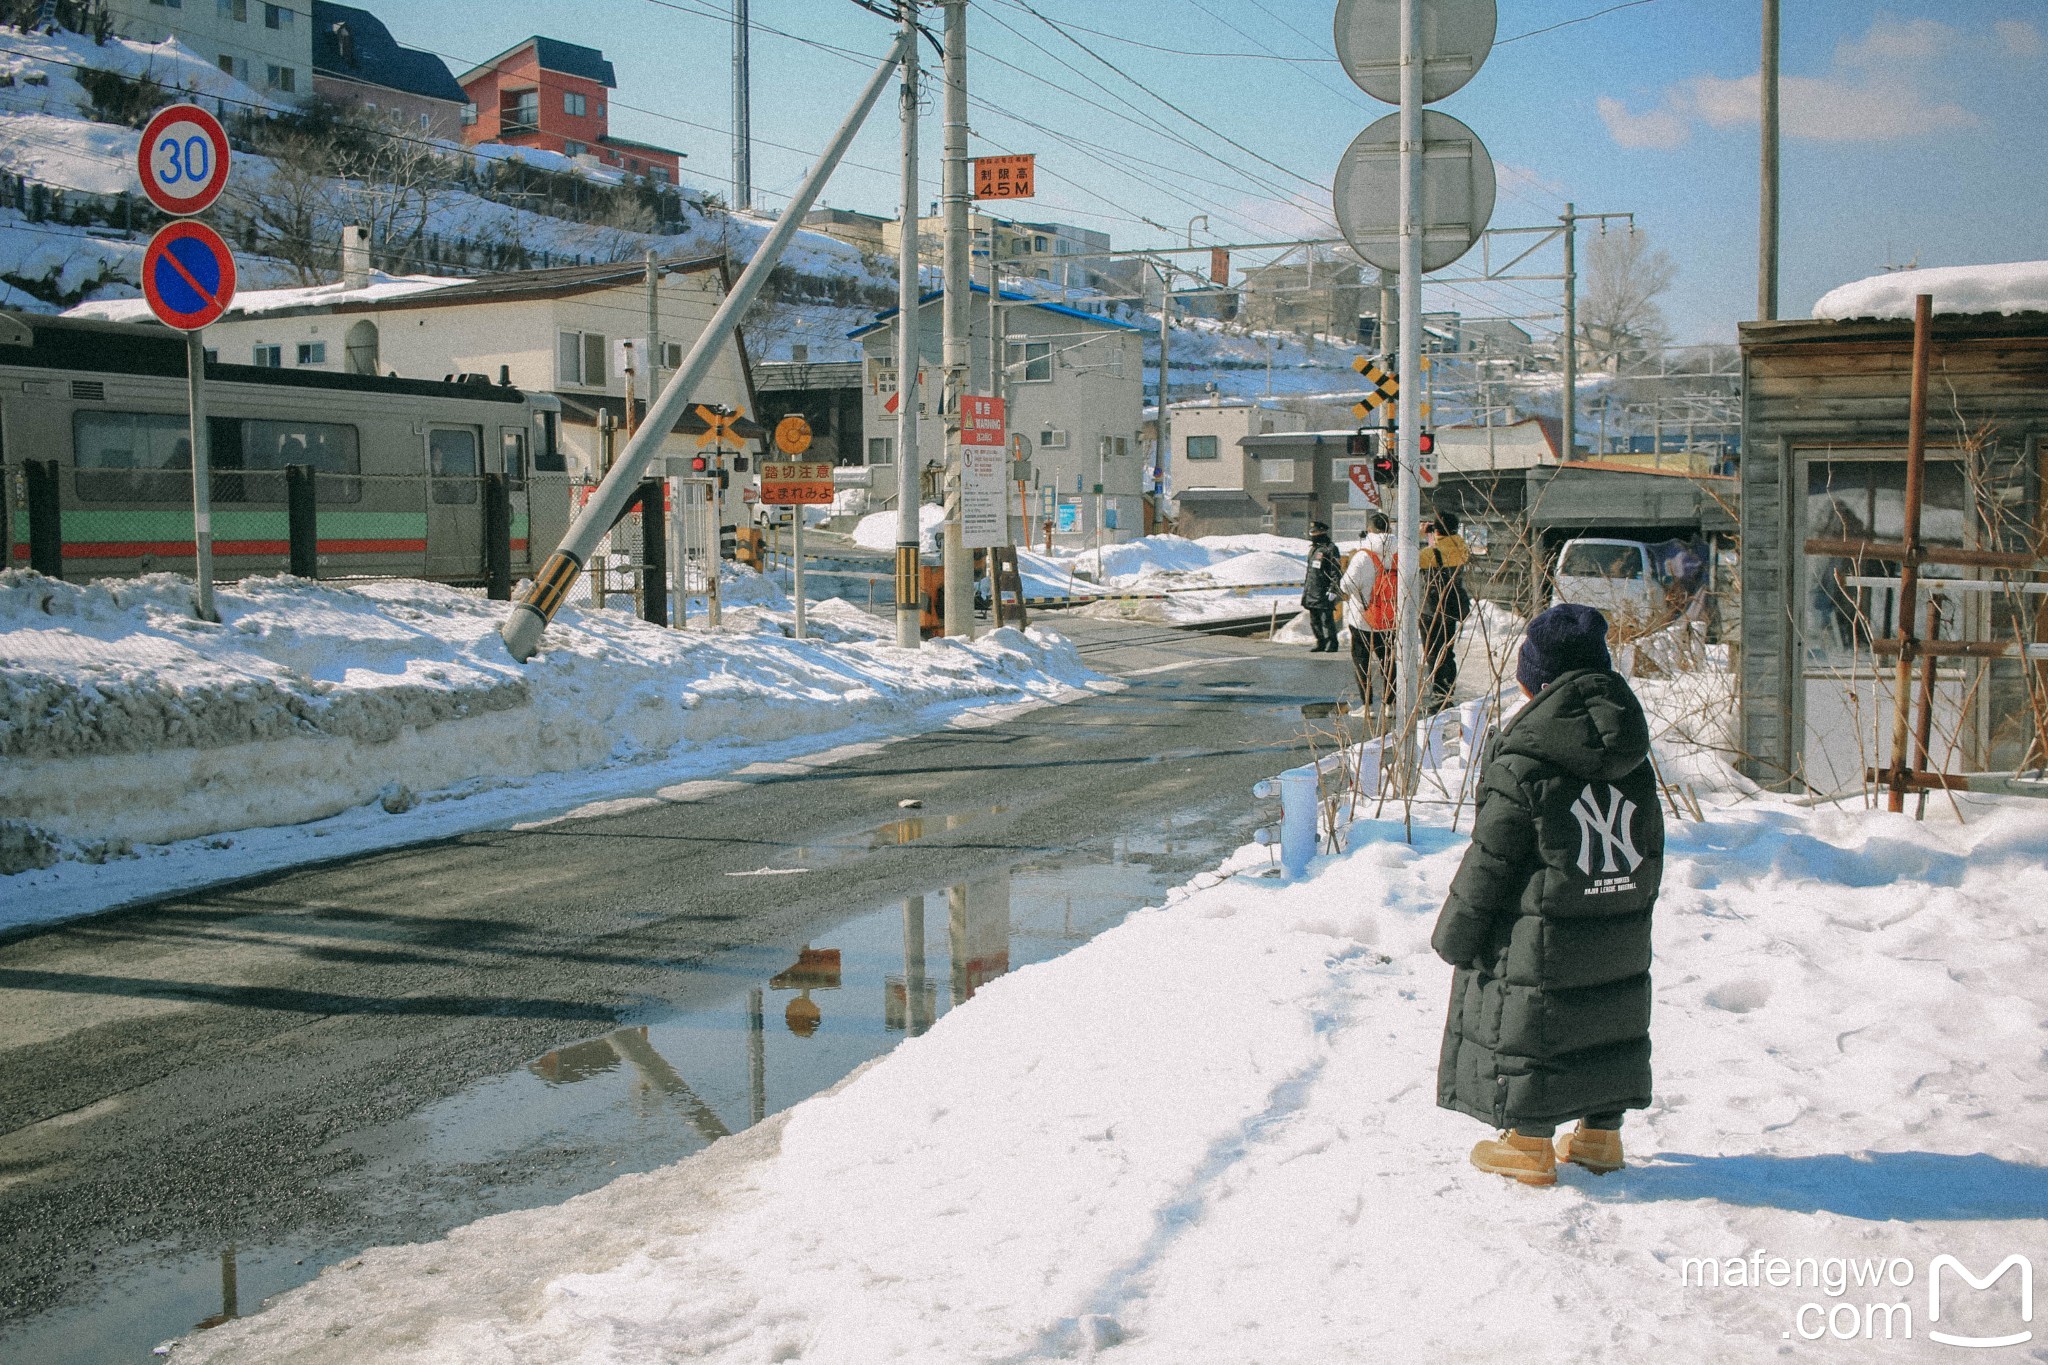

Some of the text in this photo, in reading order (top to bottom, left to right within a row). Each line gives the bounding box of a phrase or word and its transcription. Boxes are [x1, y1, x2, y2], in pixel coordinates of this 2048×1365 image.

[160, 136, 208, 184] 30
[976, 418, 1001, 430] WARNING
[764, 465, 830, 479] 踏切注意
[763, 487, 832, 500] とまれみよ
